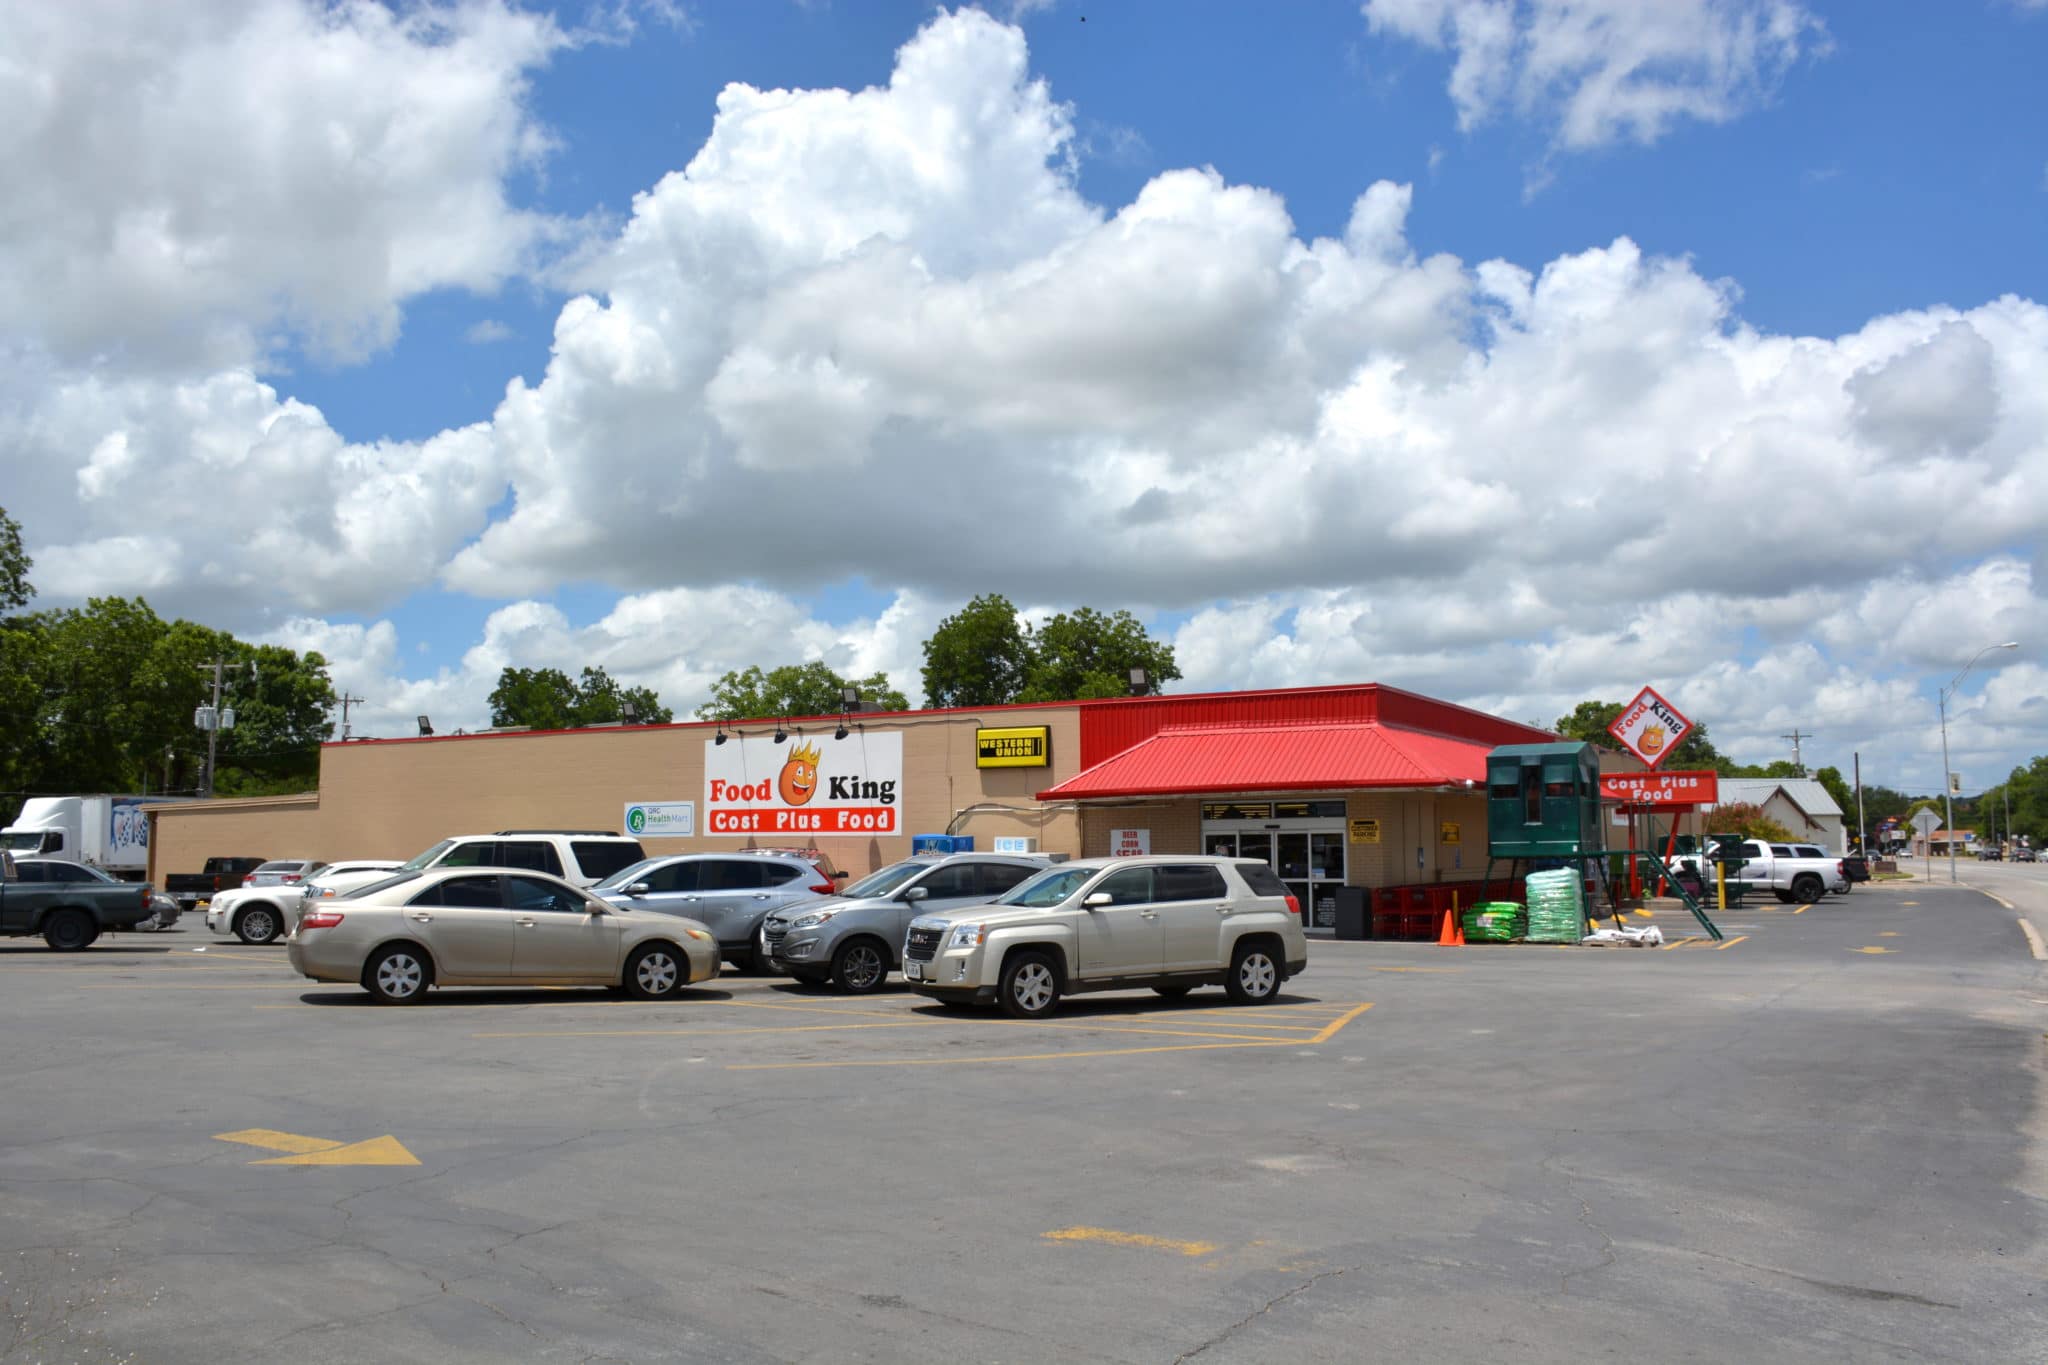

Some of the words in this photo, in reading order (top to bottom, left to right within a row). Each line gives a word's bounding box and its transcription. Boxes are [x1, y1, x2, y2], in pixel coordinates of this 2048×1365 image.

[1615, 701, 1648, 736] Food
[1649, 701, 1683, 734] King
[980, 738, 1032, 749] WESTERN
[996, 747, 1032, 757] UNION
[1607, 778, 1645, 789] Cost
[1660, 776, 1698, 788] Plus
[710, 778, 772, 802] Food
[829, 776, 896, 804] King
[1633, 788, 1673, 800] Food
[715, 812, 760, 830] Cost
[776, 811, 821, 829] Plus
[837, 811, 888, 829] Food
[996, 839, 1024, 851] ICE
